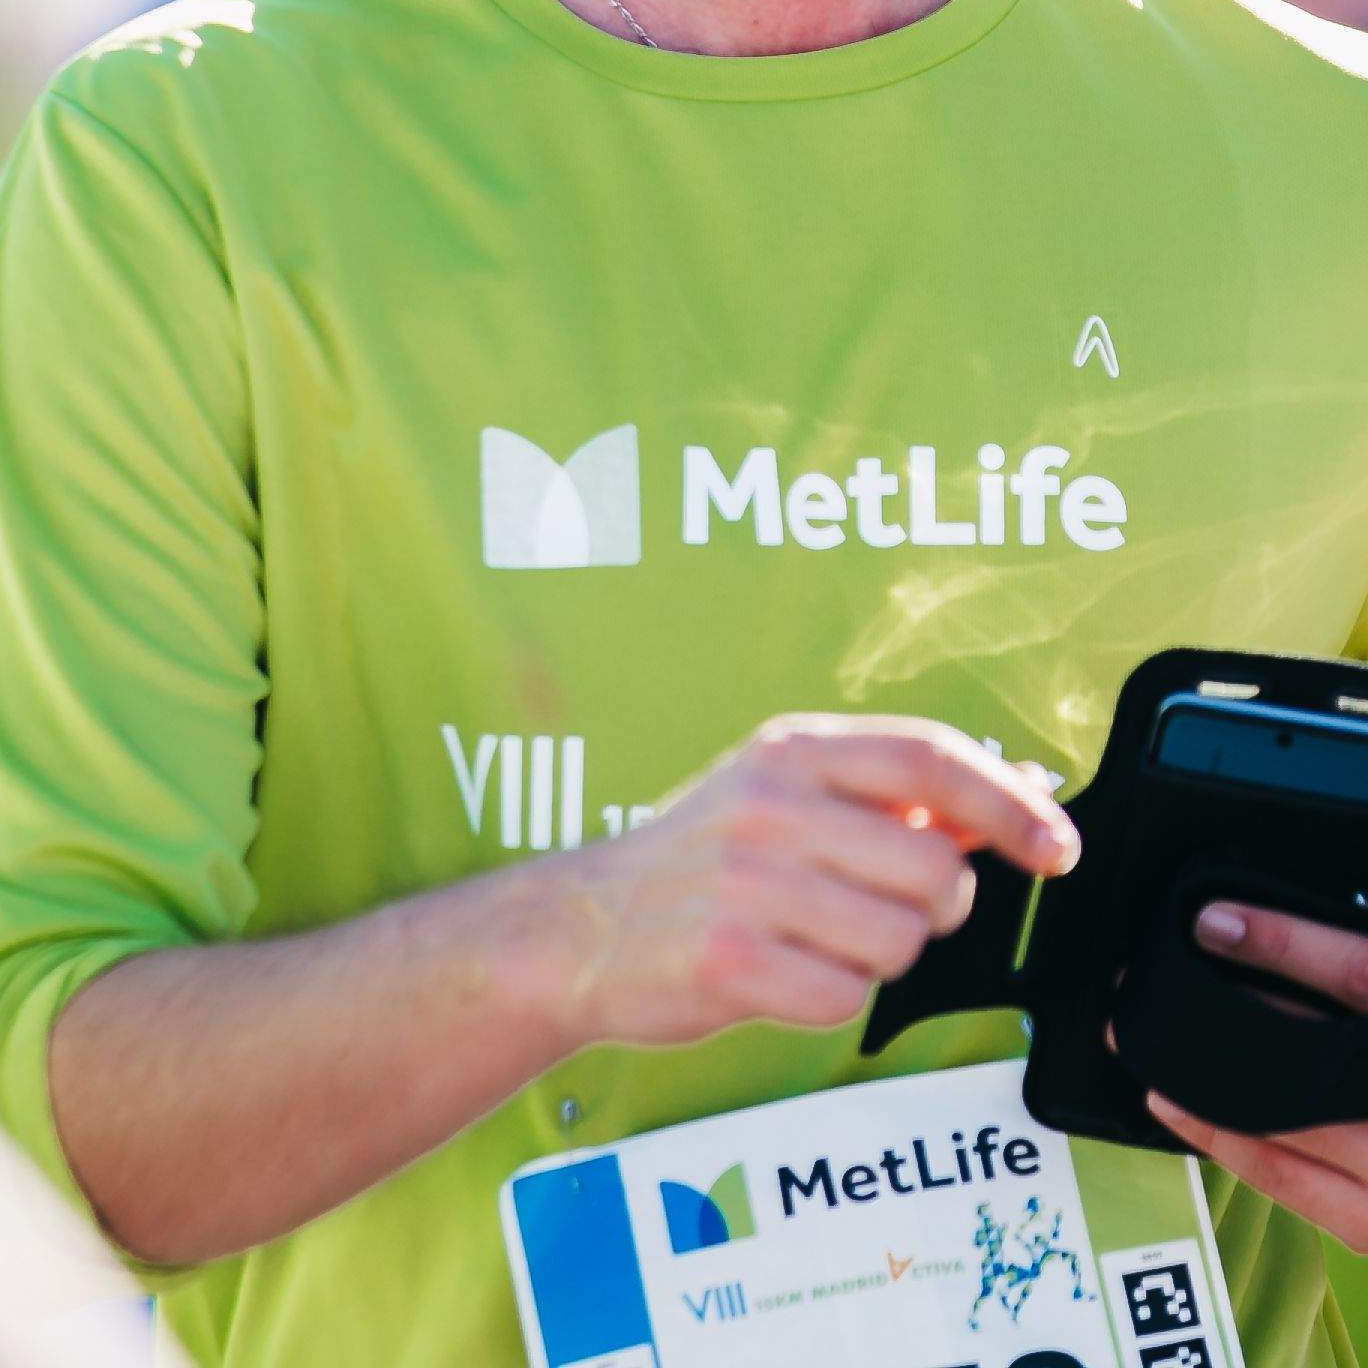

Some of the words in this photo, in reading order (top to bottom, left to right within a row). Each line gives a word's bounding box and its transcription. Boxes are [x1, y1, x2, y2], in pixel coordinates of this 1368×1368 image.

[681, 443, 1128, 552] MetLife
[439, 722, 585, 851] VIII
[778, 1126, 1041, 1219] MetLife
[682, 1281, 749, 1322] VIII
